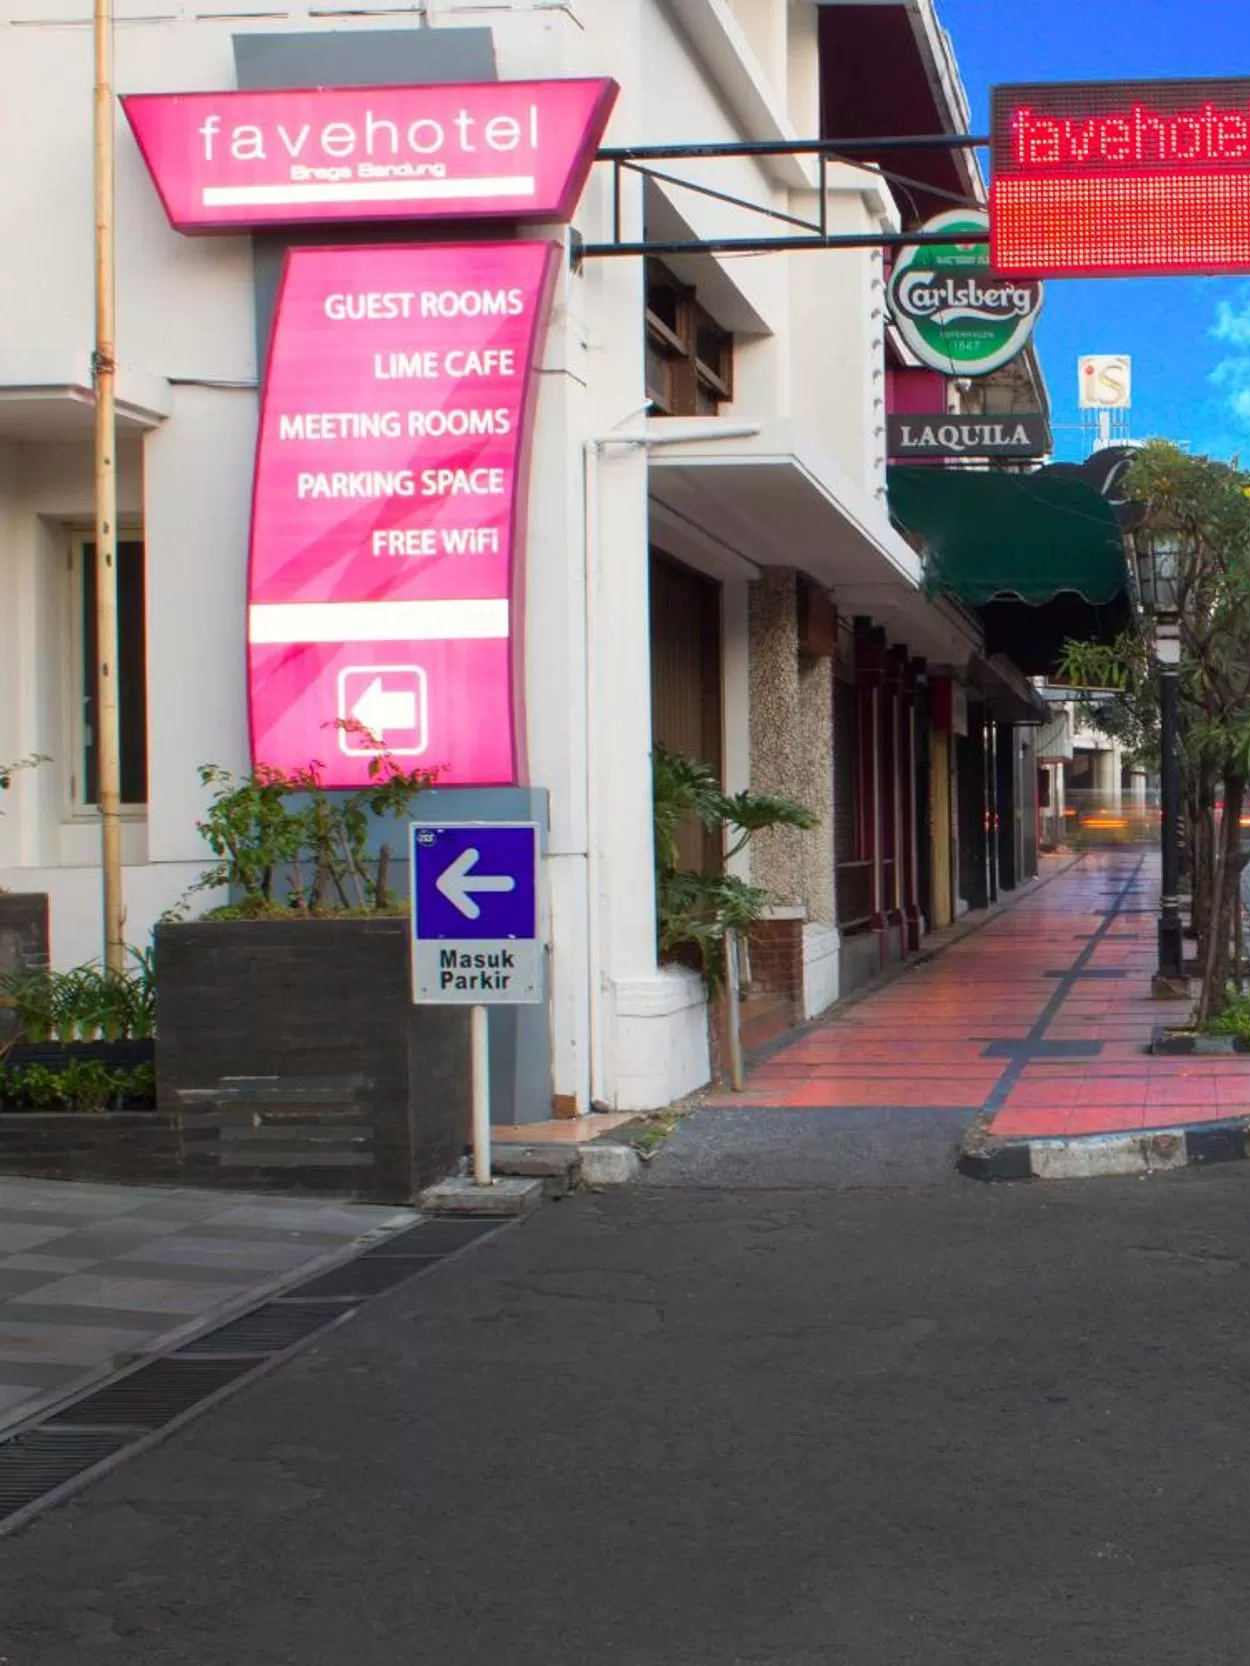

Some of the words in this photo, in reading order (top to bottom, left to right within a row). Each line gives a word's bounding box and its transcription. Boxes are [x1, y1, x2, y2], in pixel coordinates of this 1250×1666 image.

[199, 104, 540, 161] favehotel
[324, 292, 415, 320] GUEST
[420, 289, 523, 318] ROOMS
[899, 271, 1032, 318] Carlsberg
[374, 352, 439, 379] LIME
[444, 350, 515, 377] CAFE
[279, 411, 400, 440] MEETING
[407, 408, 511, 437] ROOMS
[900, 424, 1031, 451] LAQUILA
[297, 470, 416, 499] PARKING
[420, 467, 504, 496] SPACE
[372, 529, 436, 556] FREE
[441, 528, 499, 554] WiFi
[440, 949, 515, 969] Masuk
[440, 970, 511, 990] Parkir
